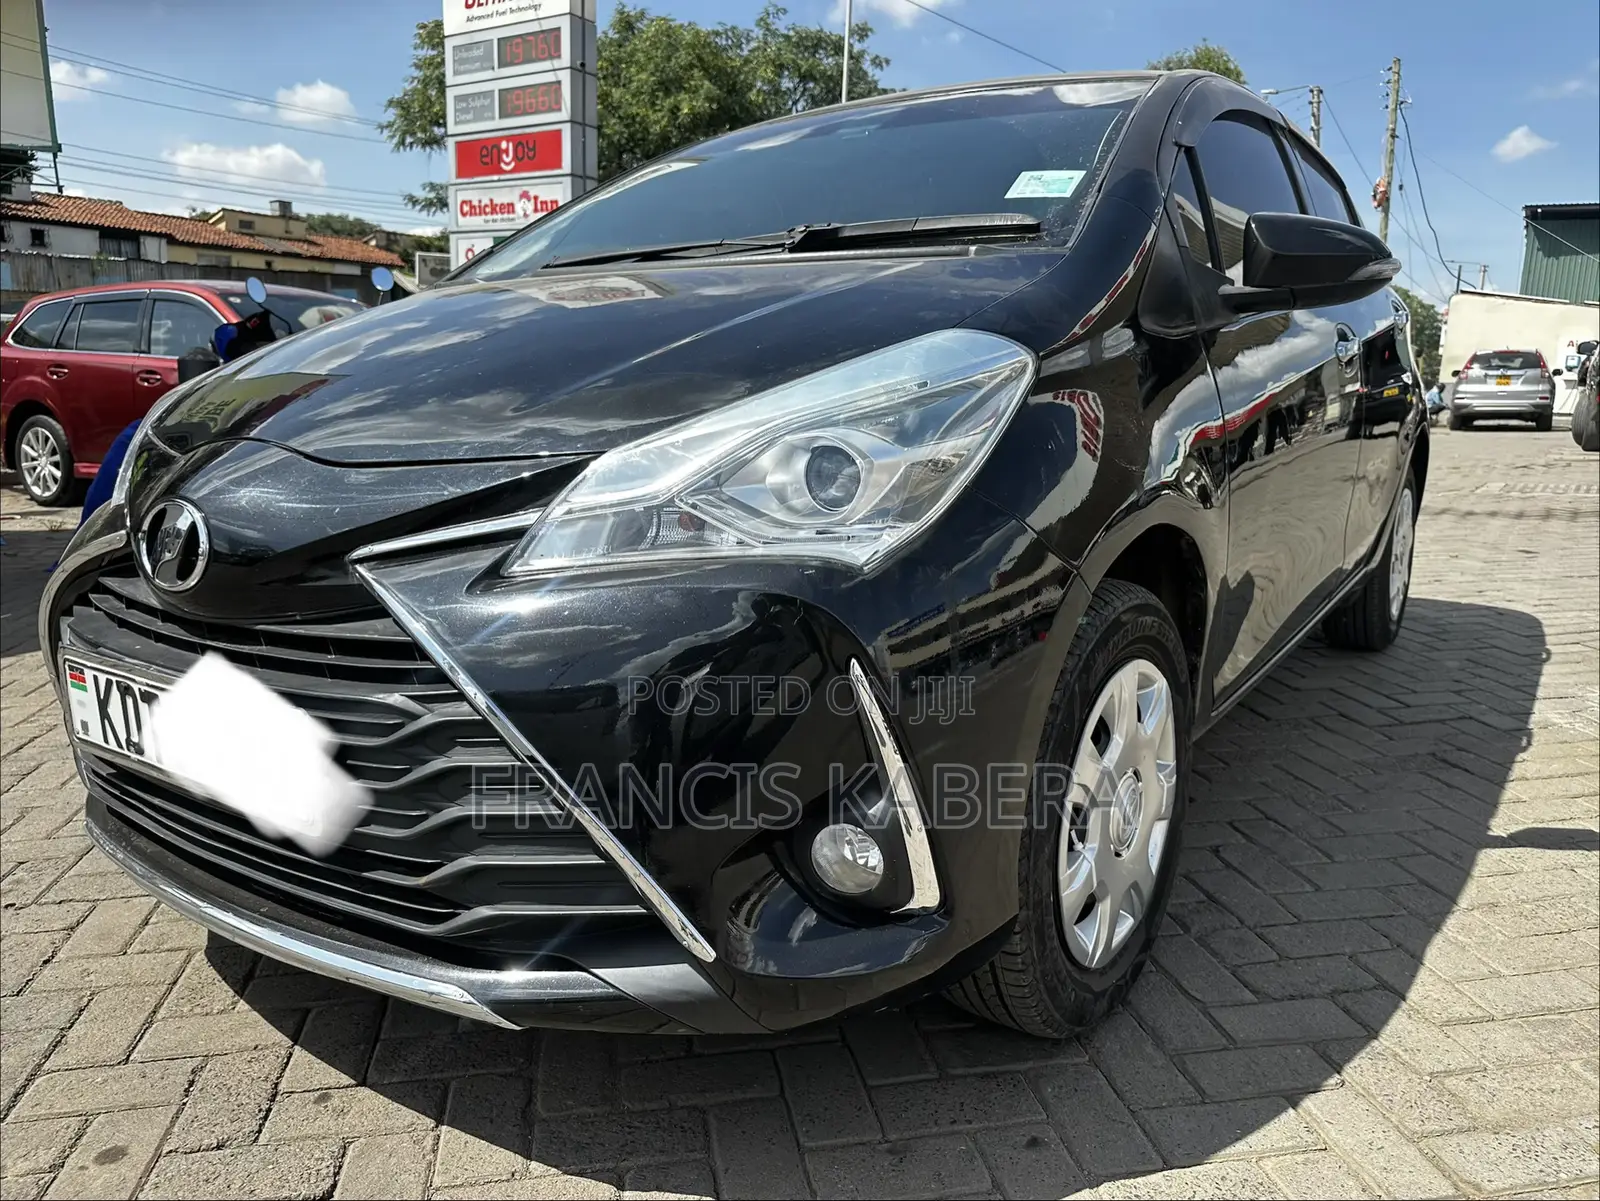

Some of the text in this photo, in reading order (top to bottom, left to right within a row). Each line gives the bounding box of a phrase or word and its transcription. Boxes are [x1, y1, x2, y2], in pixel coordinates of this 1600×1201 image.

[466, 10, 495, 23] Advanced
[495, 8, 507, 18] Fuel
[509, 3, 542, 14] Technology
[455, 99, 467, 109] Low
[455, 108, 474, 121] Diesel
[479, 139, 537, 168] enjoy
[460, 195, 559, 217] Chicken Inn
